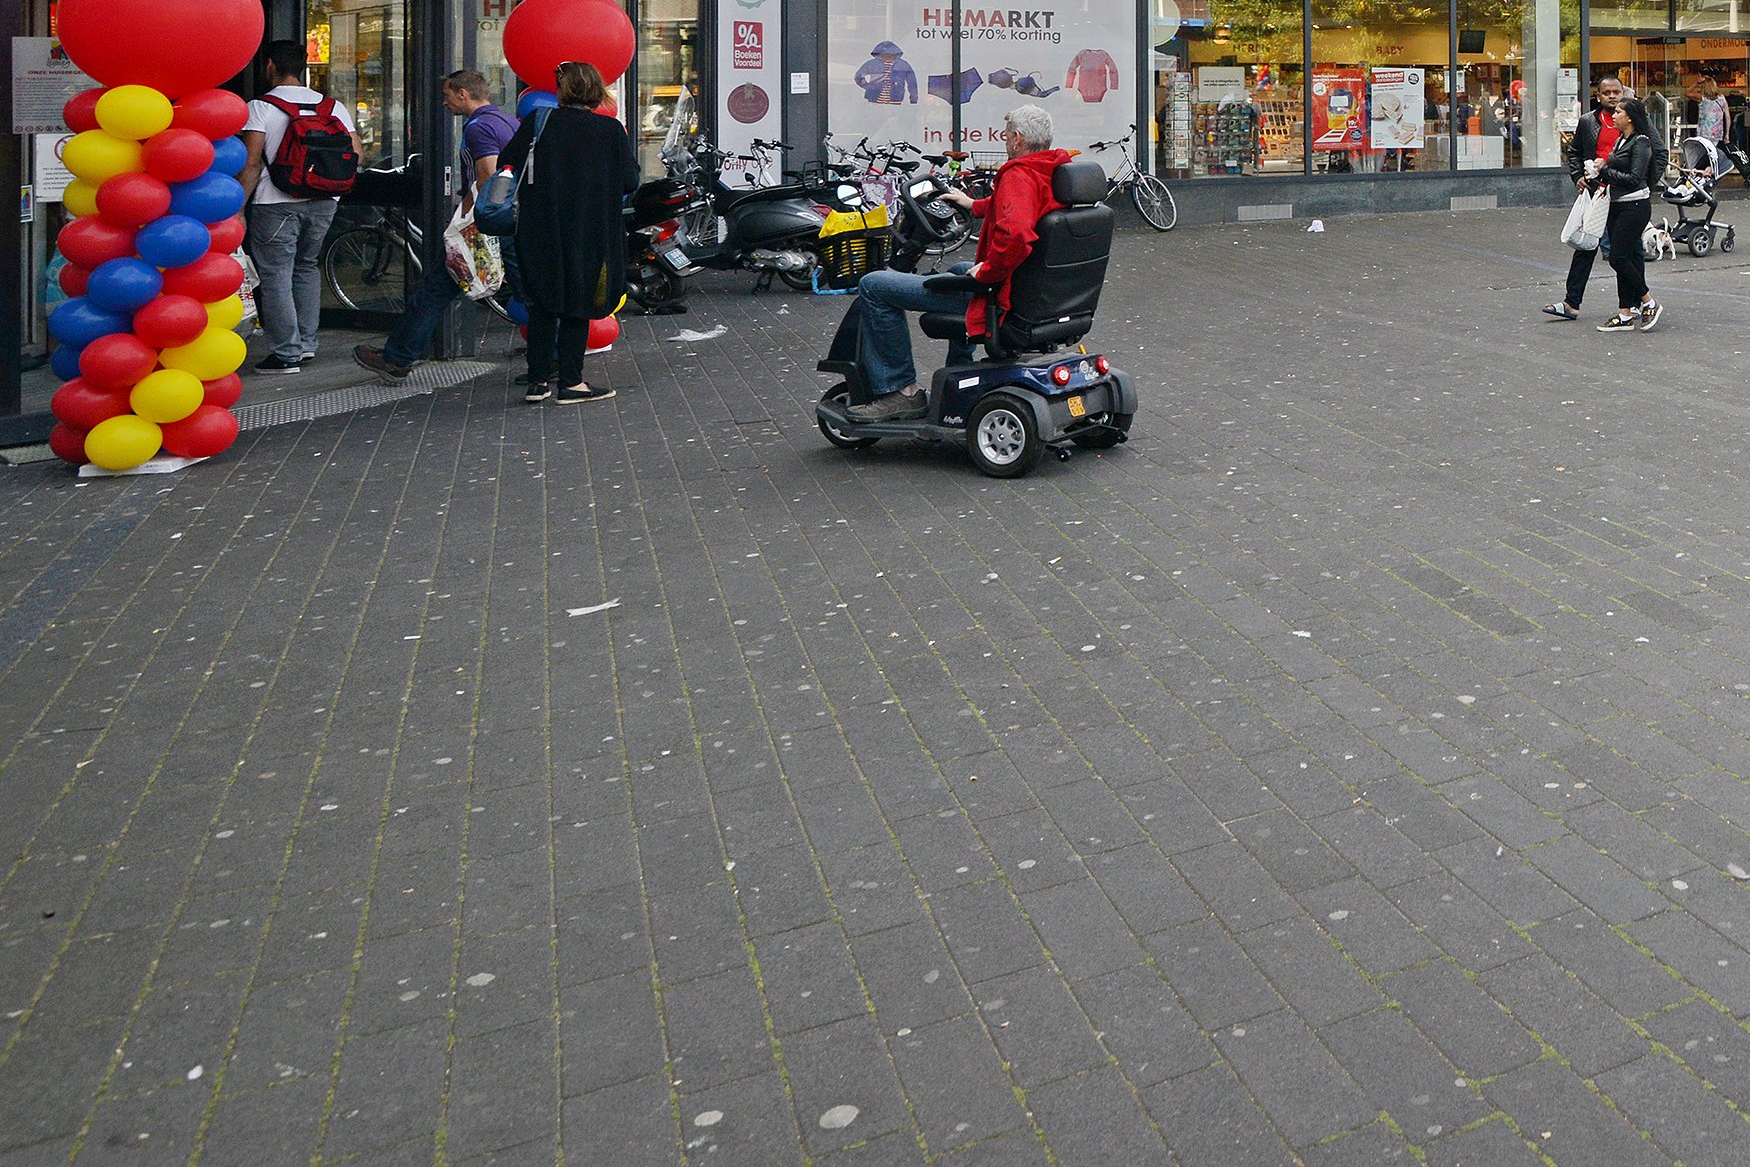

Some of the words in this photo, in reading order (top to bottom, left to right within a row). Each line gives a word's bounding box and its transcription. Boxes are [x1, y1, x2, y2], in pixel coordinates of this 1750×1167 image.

[916, 27, 937, 40] tot
[978, 28, 1006, 41] 70%
[1010, 29, 1061, 44] korting
[734, 49, 762, 59] Boeken
[734, 58, 762, 68] Voordeel
[924, 127, 942, 143] in
